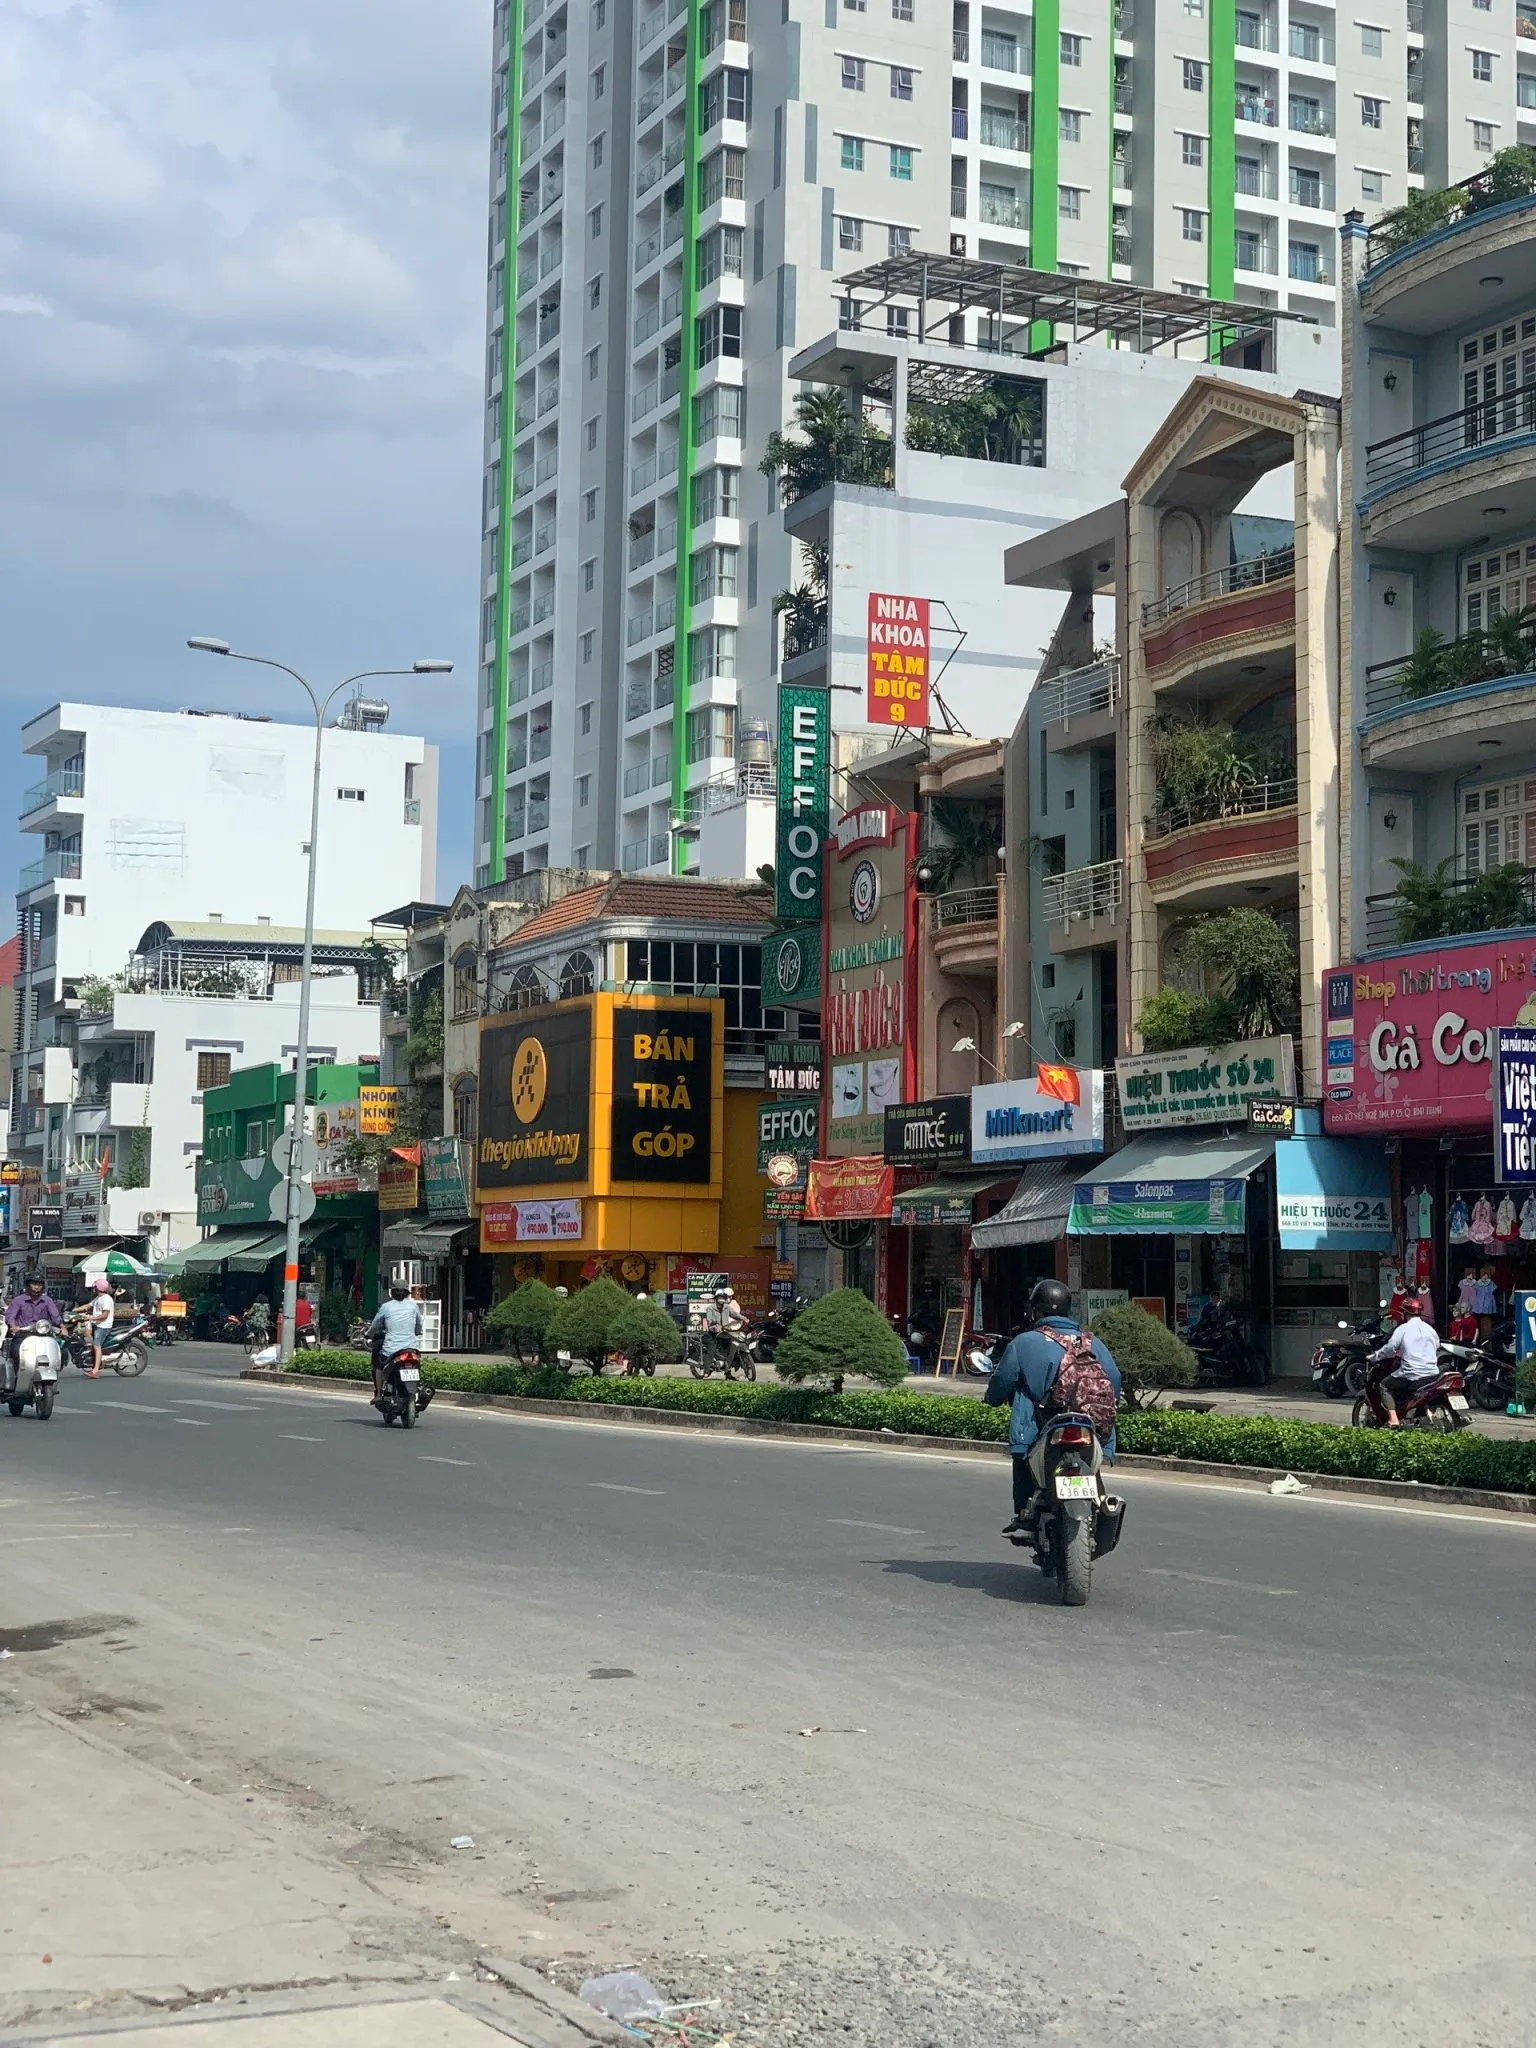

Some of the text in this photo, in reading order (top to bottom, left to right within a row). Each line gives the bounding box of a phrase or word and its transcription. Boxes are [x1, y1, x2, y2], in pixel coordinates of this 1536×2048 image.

[878, 597, 918, 622] NHA
[871, 623, 926, 648] KHOA
[872, 650, 925, 676] TÂM
[874, 676, 921, 701] ĐỨC
[890, 703, 905, 722] 9
[788, 706, 819, 900] EFFOC
[1332, 986, 1349, 1007] GAP
[1356, 975, 1396, 1007] Shop
[1399, 968, 1435, 996] Thời
[1436, 964, 1492, 994] trang
[633, 1028, 694, 1062] BÁN
[768, 1045, 821, 1064] NHA KHOA
[1329, 1048, 1352, 1060] PLACE
[1370, 1020, 1420, 1072] Gà
[1522, 1039, 1530, 1052] CAO
[769, 1064, 821, 1090] TÂM ĐỨC
[1126, 1053, 1274, 1102] HIỆU THUỐC SỐ 24
[362, 1089, 397, 1102] NHÔM
[633, 1075, 692, 1110] TRẢ
[1330, 1090, 1352, 1099] OLD NAVY
[364, 1105, 395, 1118] KÍNH
[985, 1101, 1073, 1138] Milkmart
[1252, 1110, 1285, 1123] Gà Con
[761, 1108, 816, 1141] EFFOC
[632, 1125, 695, 1158] GÓP
[1134, 1183, 1174, 1200] Salonpas
[1281, 1201, 1388, 1220] HIỆU THUỐC 24
[1090, 1296, 1104, 1309] HIỆU
